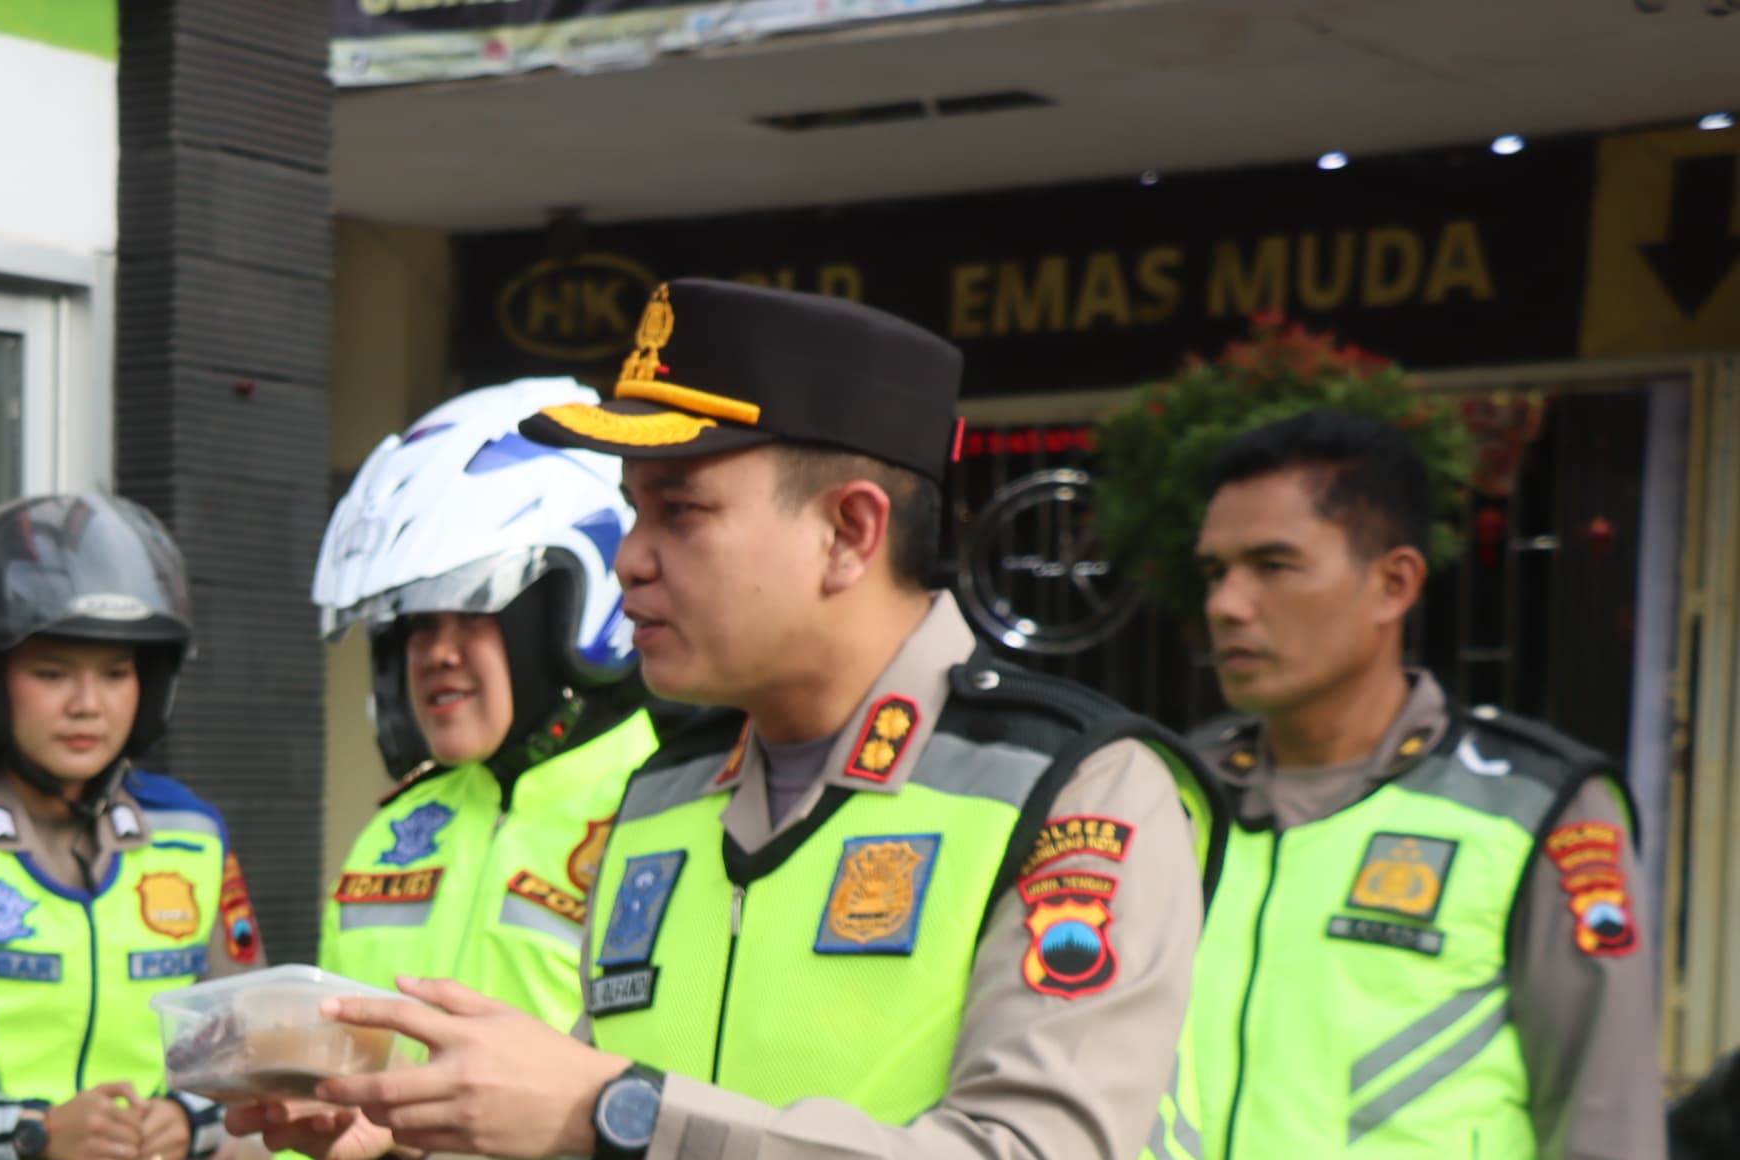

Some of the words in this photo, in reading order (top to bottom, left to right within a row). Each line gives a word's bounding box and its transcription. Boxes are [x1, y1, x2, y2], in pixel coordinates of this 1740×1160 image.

[526, 276, 632, 335] HK
[947, 244, 1184, 339] EMAS
[1206, 220, 1497, 317] MUDA
